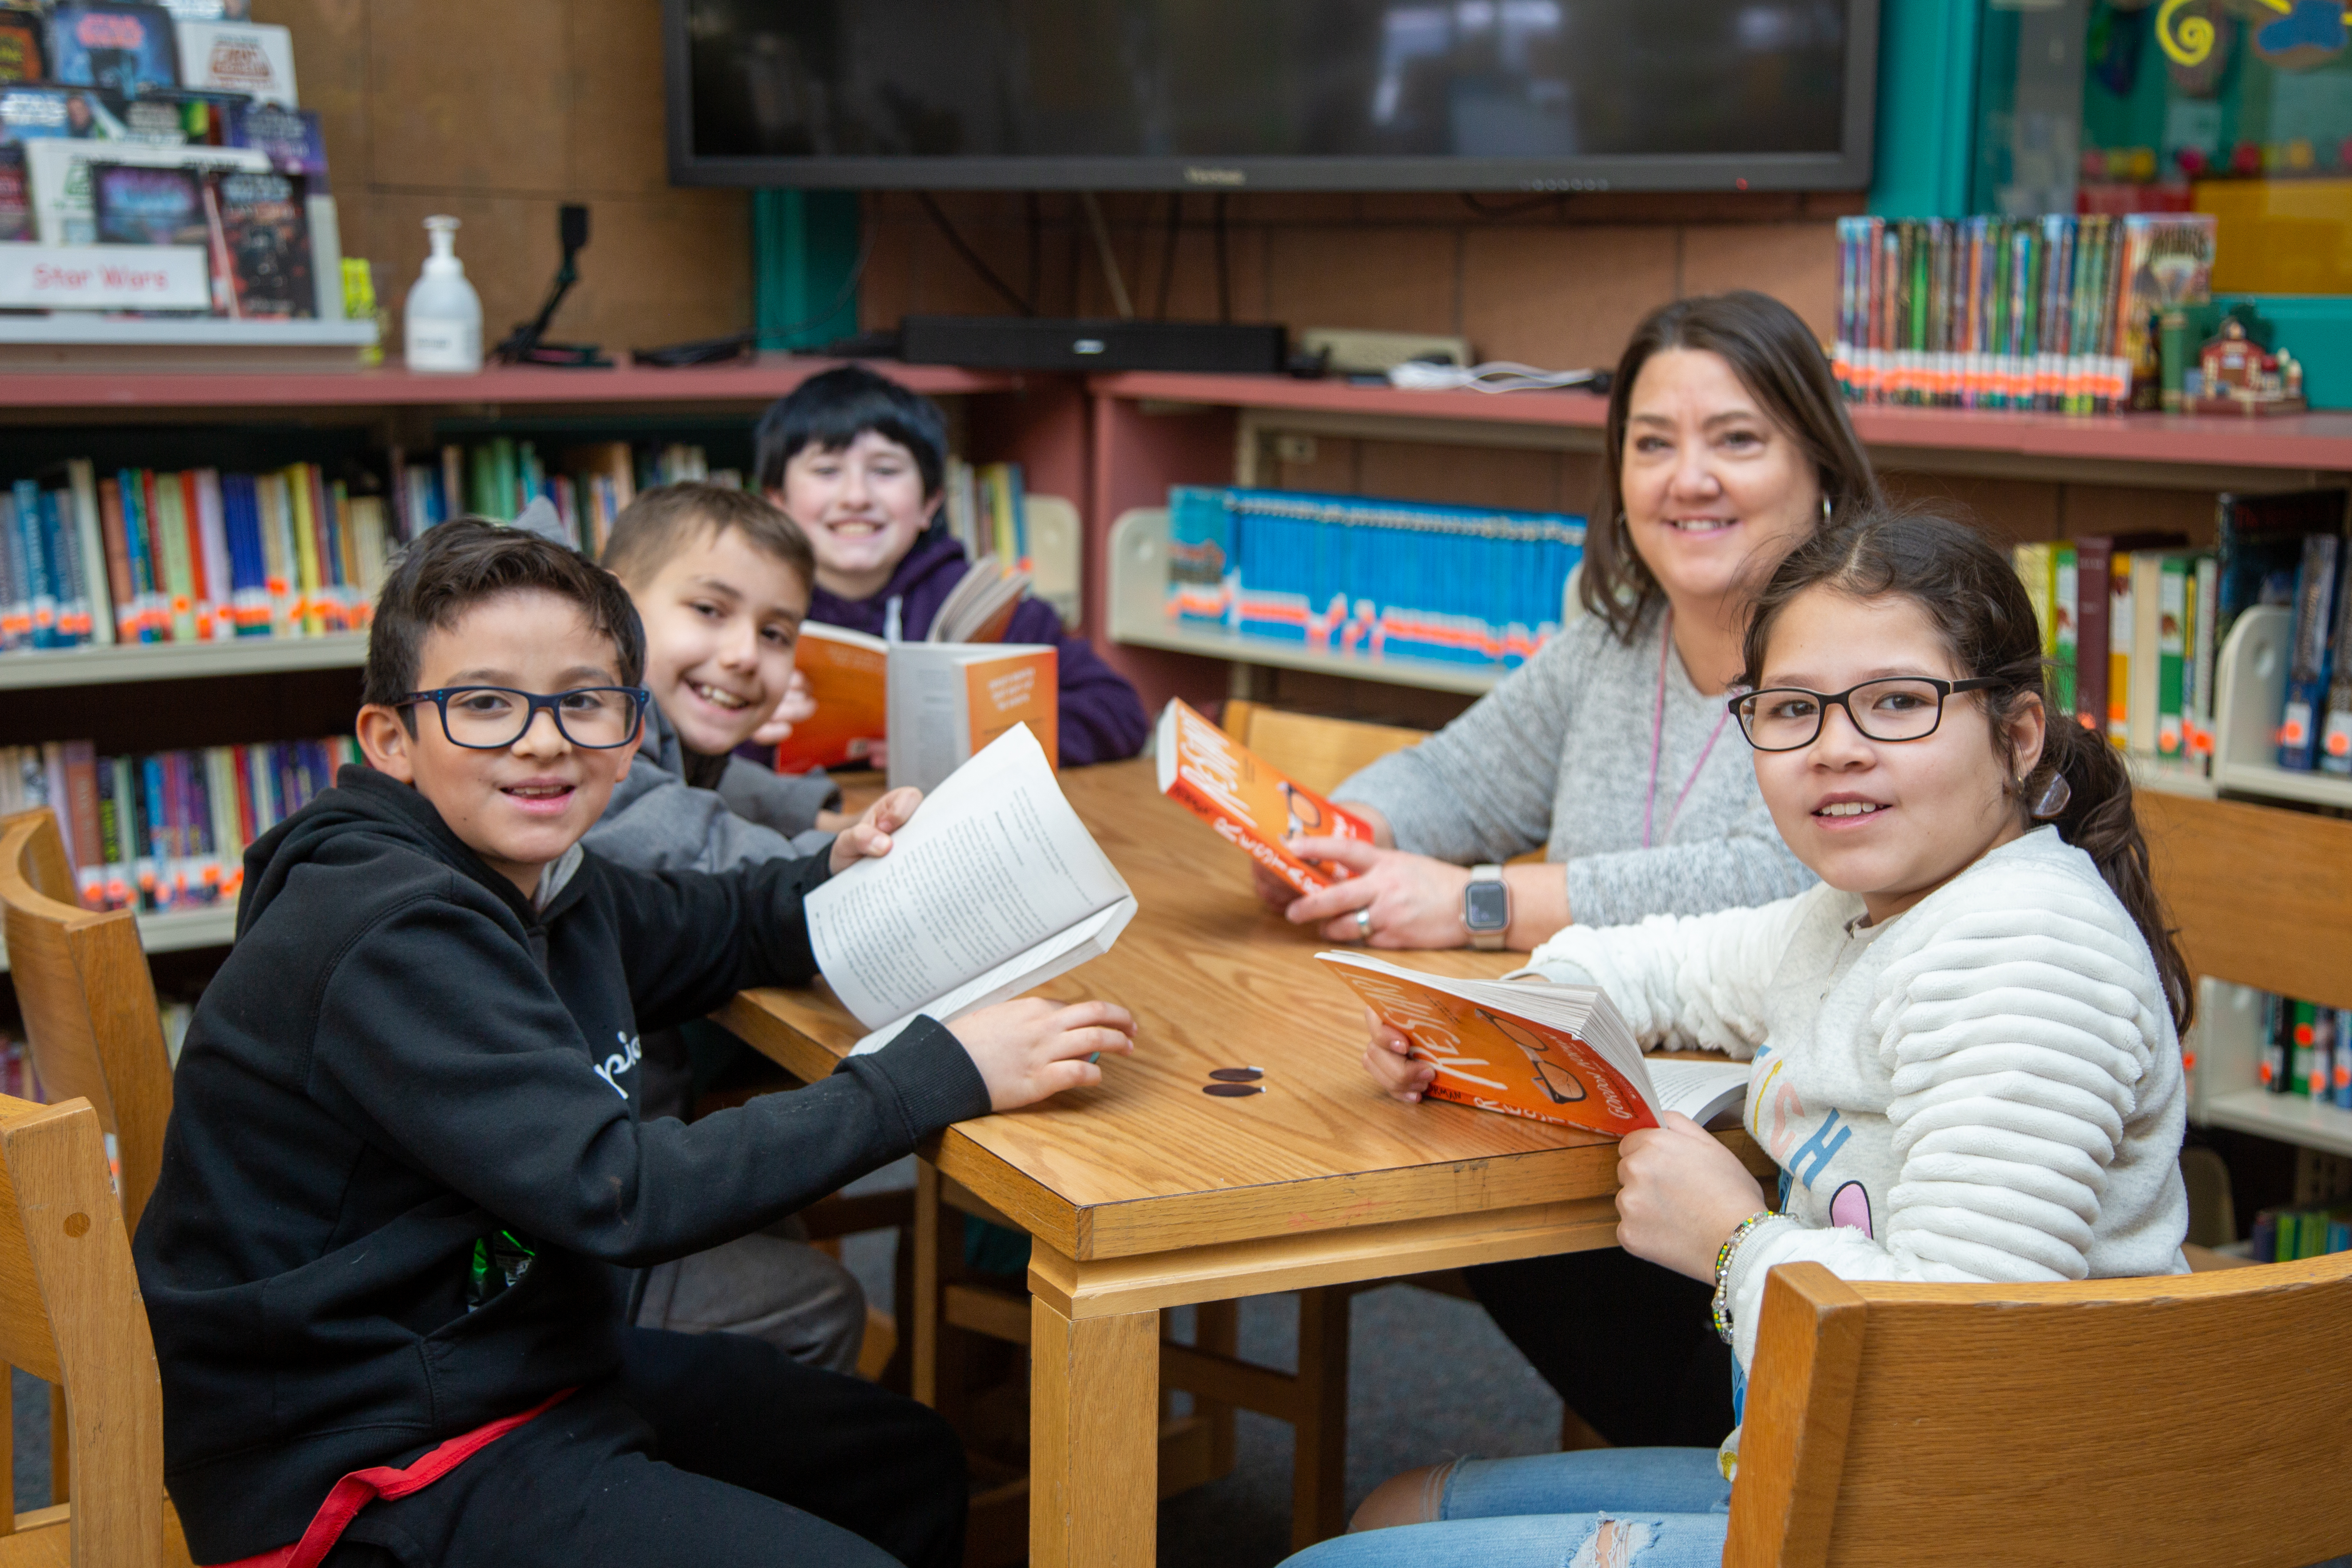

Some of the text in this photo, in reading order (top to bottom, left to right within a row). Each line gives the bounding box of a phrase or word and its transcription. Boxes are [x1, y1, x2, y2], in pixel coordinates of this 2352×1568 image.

[33, 263, 169, 290] Star Wars
[1213, 816, 1326, 893] RESTAR
[1335, 966, 1509, 1091] RESTART
[1586, 1070, 1633, 1120] GORDON
